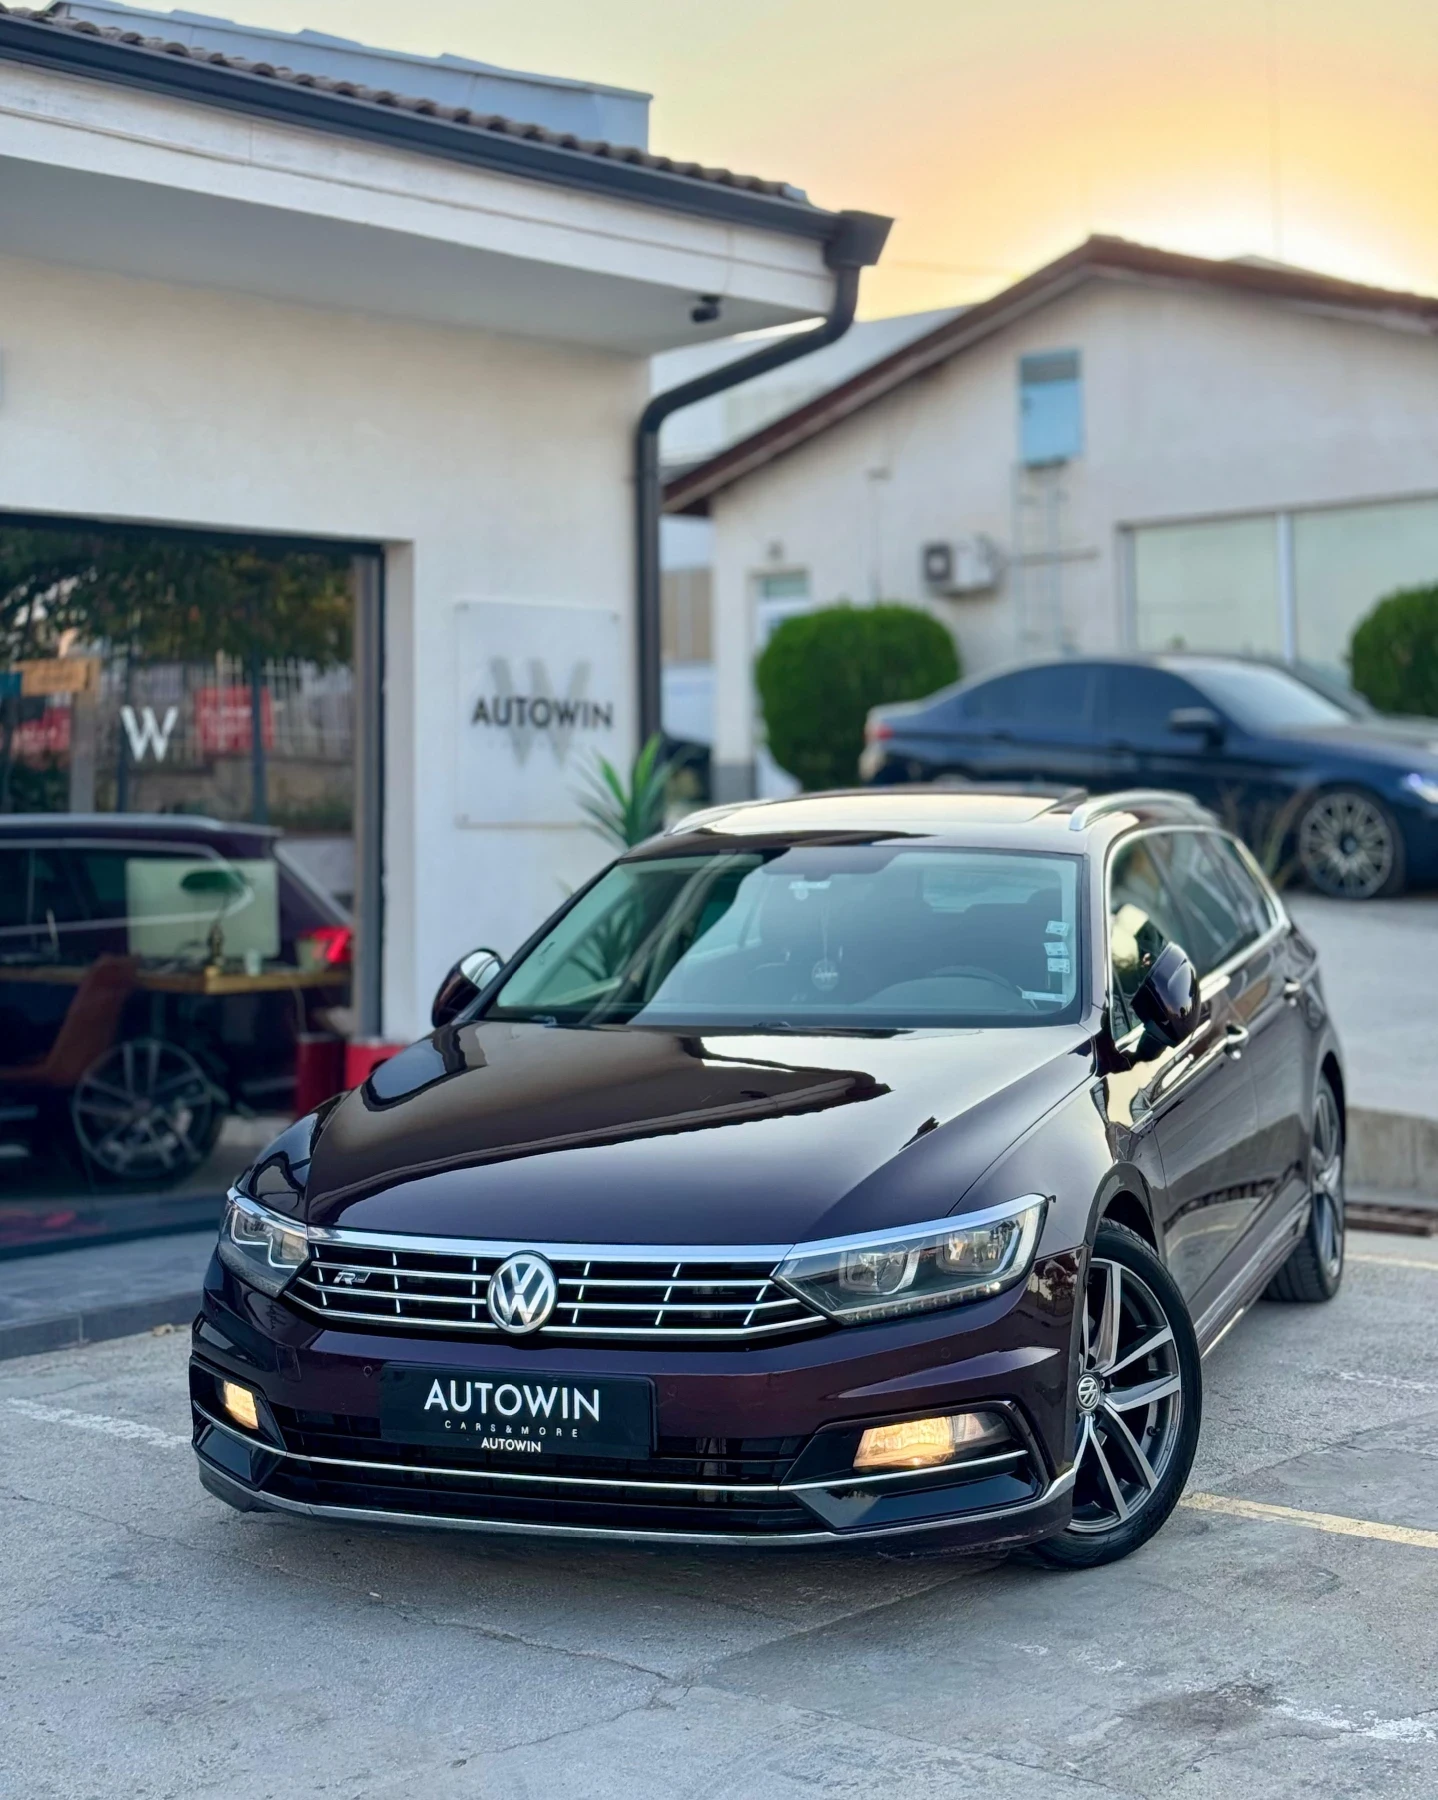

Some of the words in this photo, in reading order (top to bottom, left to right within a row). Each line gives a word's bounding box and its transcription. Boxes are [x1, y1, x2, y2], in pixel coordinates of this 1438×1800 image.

[470, 695, 614, 731] AUTOWIN
[120, 705, 179, 762] W
[424, 1378, 600, 1422] AUTOWIN
[481, 1436, 541, 1453] AUTOWIN
